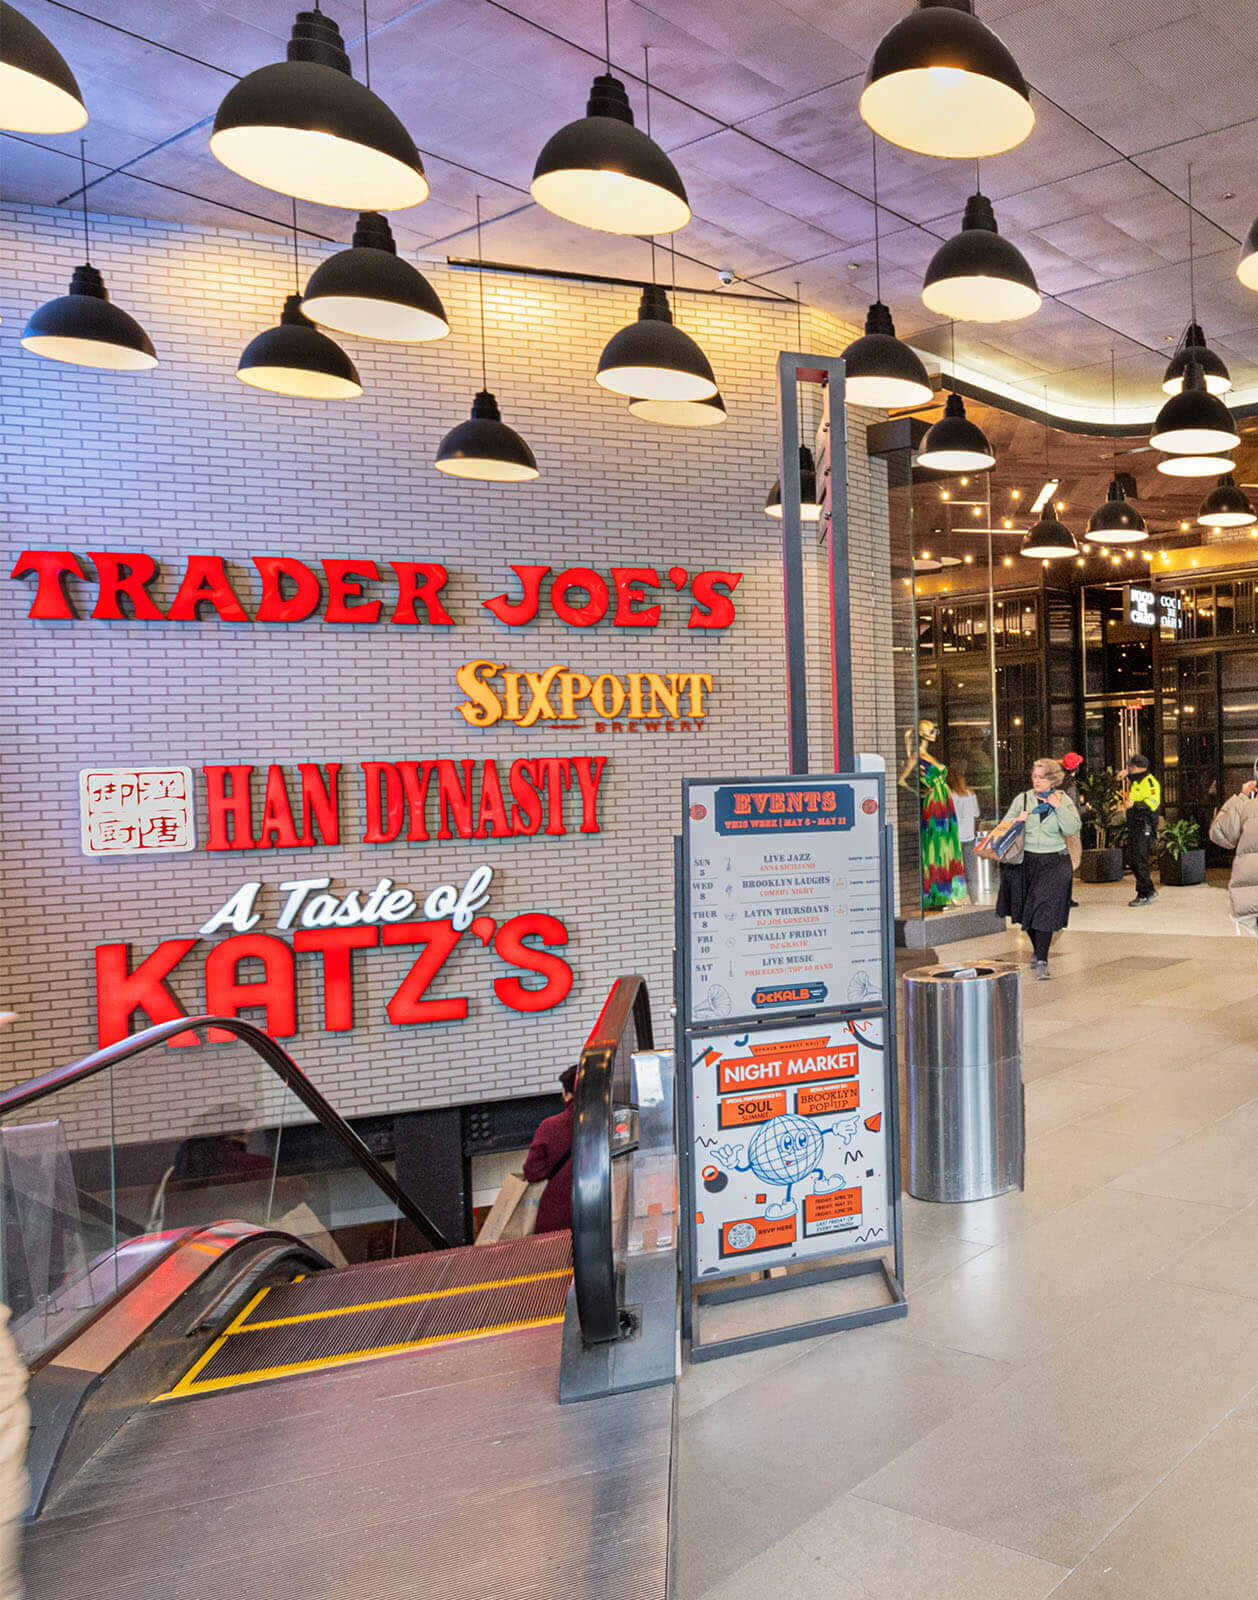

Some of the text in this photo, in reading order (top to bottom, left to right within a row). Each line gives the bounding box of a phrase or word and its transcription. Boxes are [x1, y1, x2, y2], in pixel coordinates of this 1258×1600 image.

[10, 551, 744, 630] TRADER JOE'S
[455, 659, 713, 727] SIXPOINT
[594, 720, 705, 733] BREWERY
[203, 756, 607, 852] HAN DYNASTY
[733, 791, 837, 814] EVENTS
[724, 820, 749, 829] THIS
[750, 819, 778, 828] WEEK
[784, 818, 803, 827] MAY
[817, 817, 836, 825] MAY
[694, 858, 711, 866] SUN
[763, 853, 811, 863] LIVE JAZZ
[692, 882, 714, 890] WED
[742, 877, 793, 888] BROOKLYN
[795, 876, 830, 885] LAUGHS
[791, 887, 814, 895] NIGHT
[200, 866, 494, 935] A Taste of
[692, 911, 717, 919] THUR
[744, 904, 829, 918] LATIN THURSDAYS
[747, 929, 827, 943] FINALLY FRIDAY!
[762, 954, 814, 966] LIVE MUSIC
[695, 963, 713, 972] SAT
[95, 912, 574, 1051] KATZ'S
[724, 1052, 856, 1083] NIGHT MARKET
[801, 1088, 857, 1104] BROOKLYN
[738, 1101, 773, 1115] SOUL
[742, 1112, 769, 1121] SUMMIT
